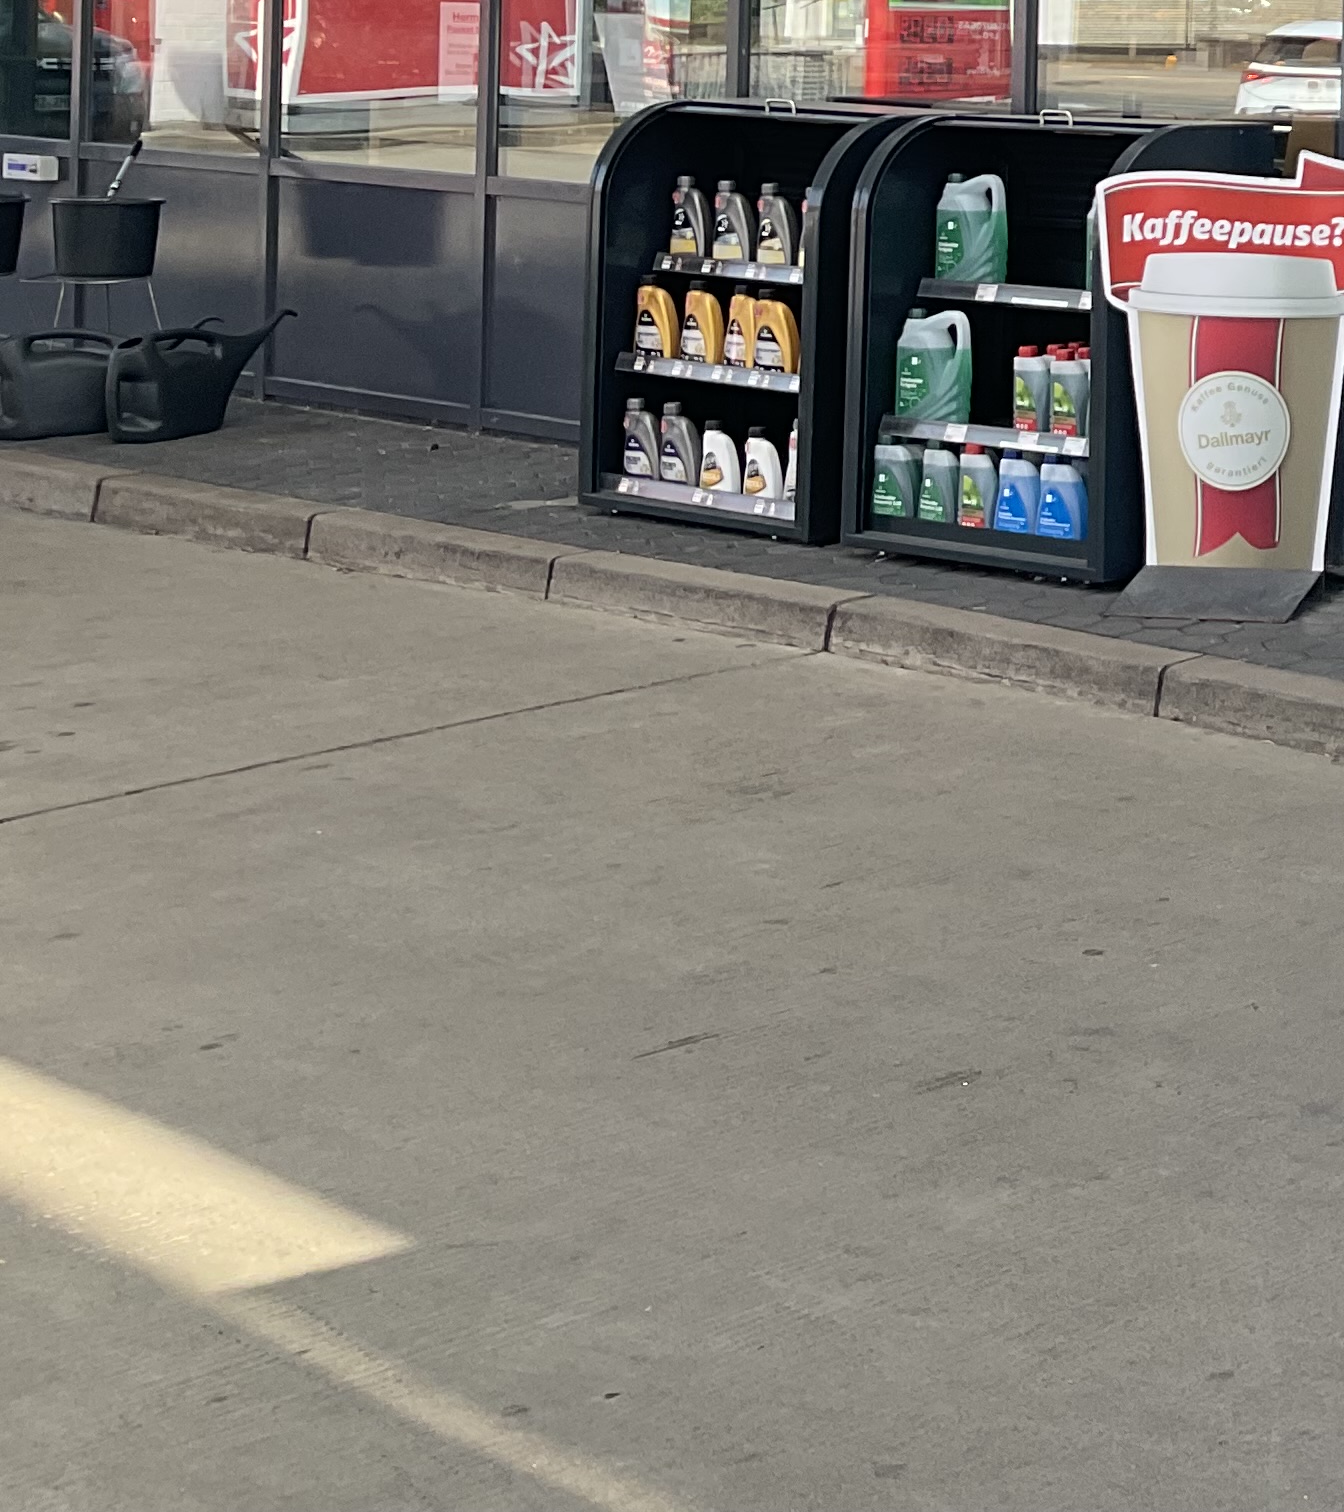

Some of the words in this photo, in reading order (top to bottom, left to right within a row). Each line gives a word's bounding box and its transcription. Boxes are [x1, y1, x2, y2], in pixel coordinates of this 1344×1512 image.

[1227, 381, 1269, 405] Genuss
[1197, 429, 1272, 450] Dallmayr
[1206, 455, 1268, 478] garantiert
